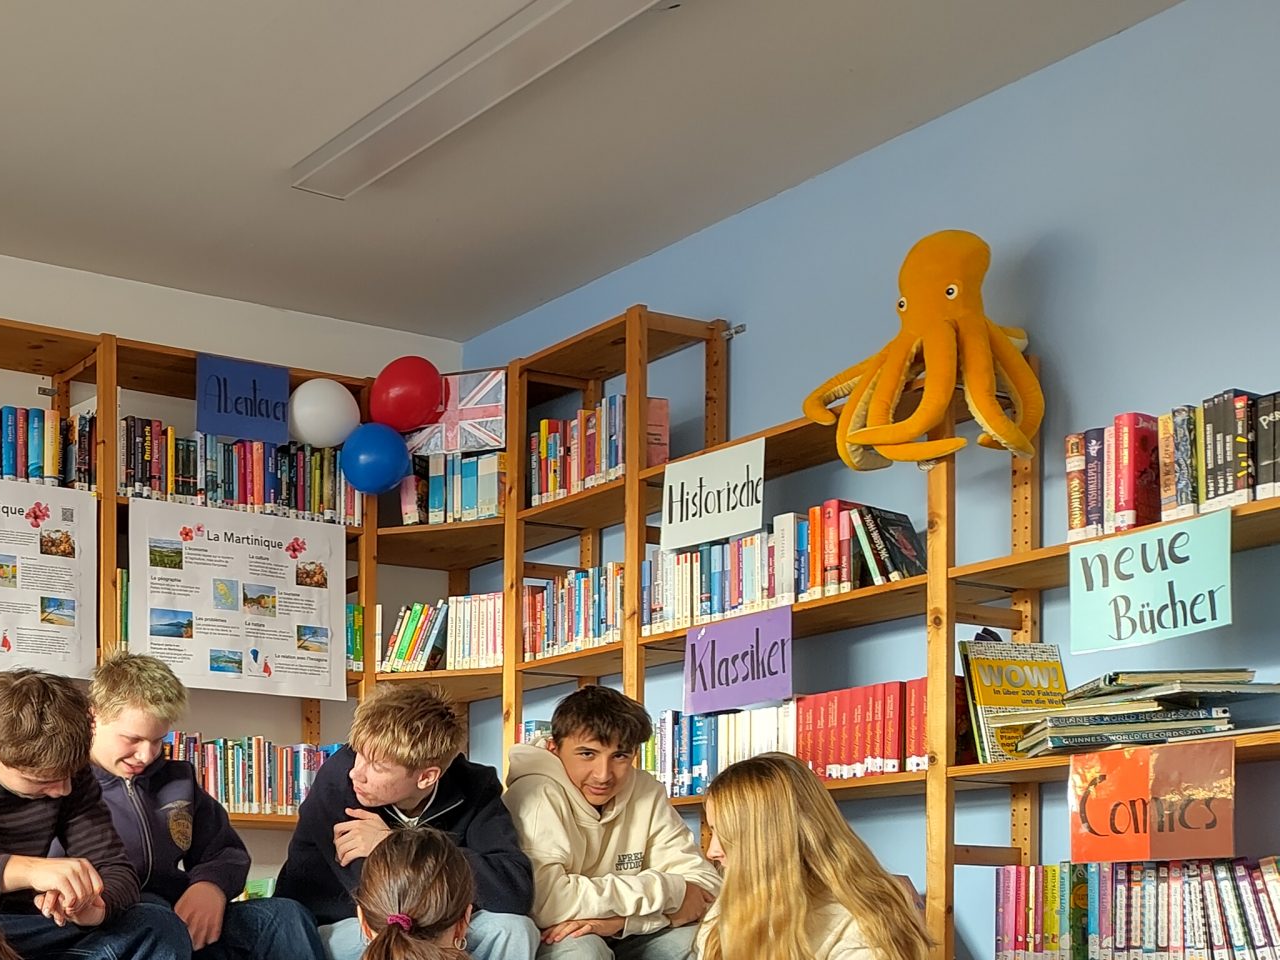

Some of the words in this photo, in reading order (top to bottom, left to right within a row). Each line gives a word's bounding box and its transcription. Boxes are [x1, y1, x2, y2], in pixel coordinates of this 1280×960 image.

[667, 464, 764, 525] Historische
[1087, 460, 1098, 510] WISHKEEPER
[207, 530, 220, 542] La
[223, 532, 284, 550] Martinique
[1080, 531, 1191, 592] neue
[1108, 581, 1226, 641] Bücher
[689, 628, 790, 693] Klassiker
[978, 664, 1060, 689] WOW!
[1052, 716, 1101, 725] GUINNESS
[1103, 714, 1136, 722] WORLD
[1139, 710, 1184, 720] RECORDS
[1062, 734, 1107, 744] GUINNESS
[1108, 732, 1140, 741] WORLD
[1142, 730, 1182, 739] RECORDS
[1079, 774, 1218, 838] Comics
